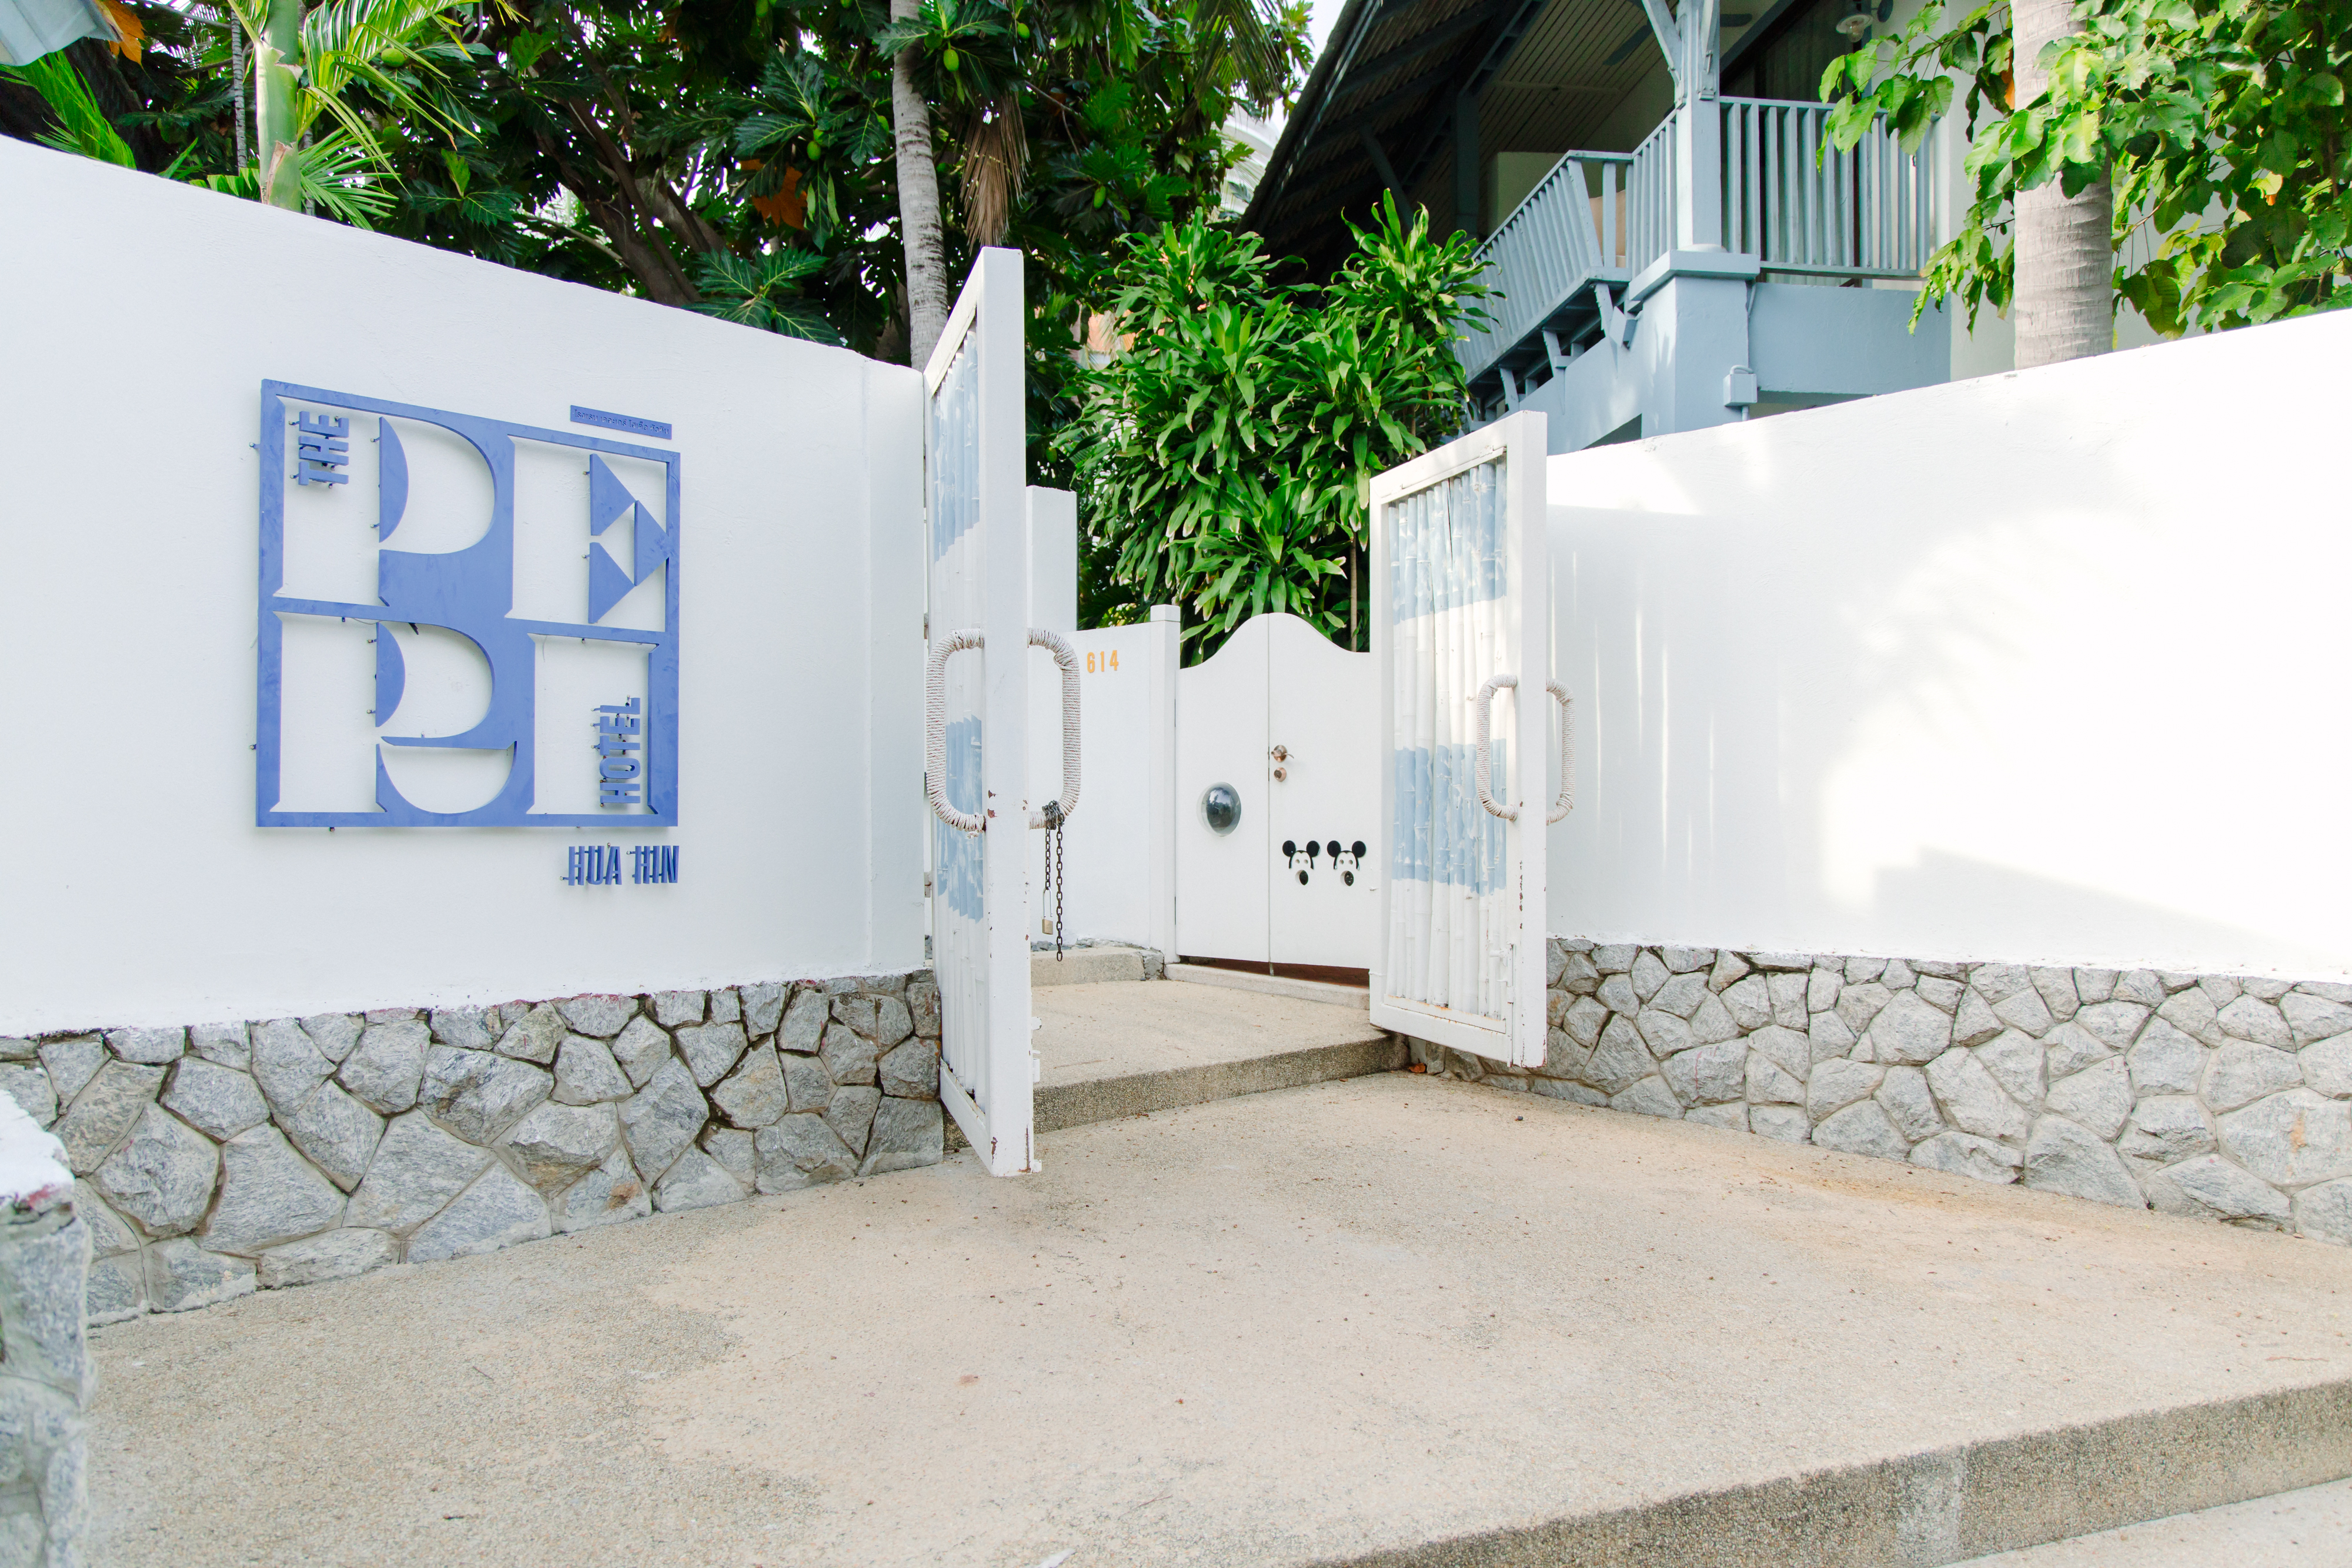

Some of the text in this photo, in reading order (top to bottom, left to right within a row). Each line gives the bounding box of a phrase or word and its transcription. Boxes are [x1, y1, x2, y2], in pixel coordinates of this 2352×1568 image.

[298, 411, 349, 486] THE
[1087, 650, 1119, 673] 614
[599, 697, 641, 804] HOTEL
[568, 845, 680, 886] HUA HIN
